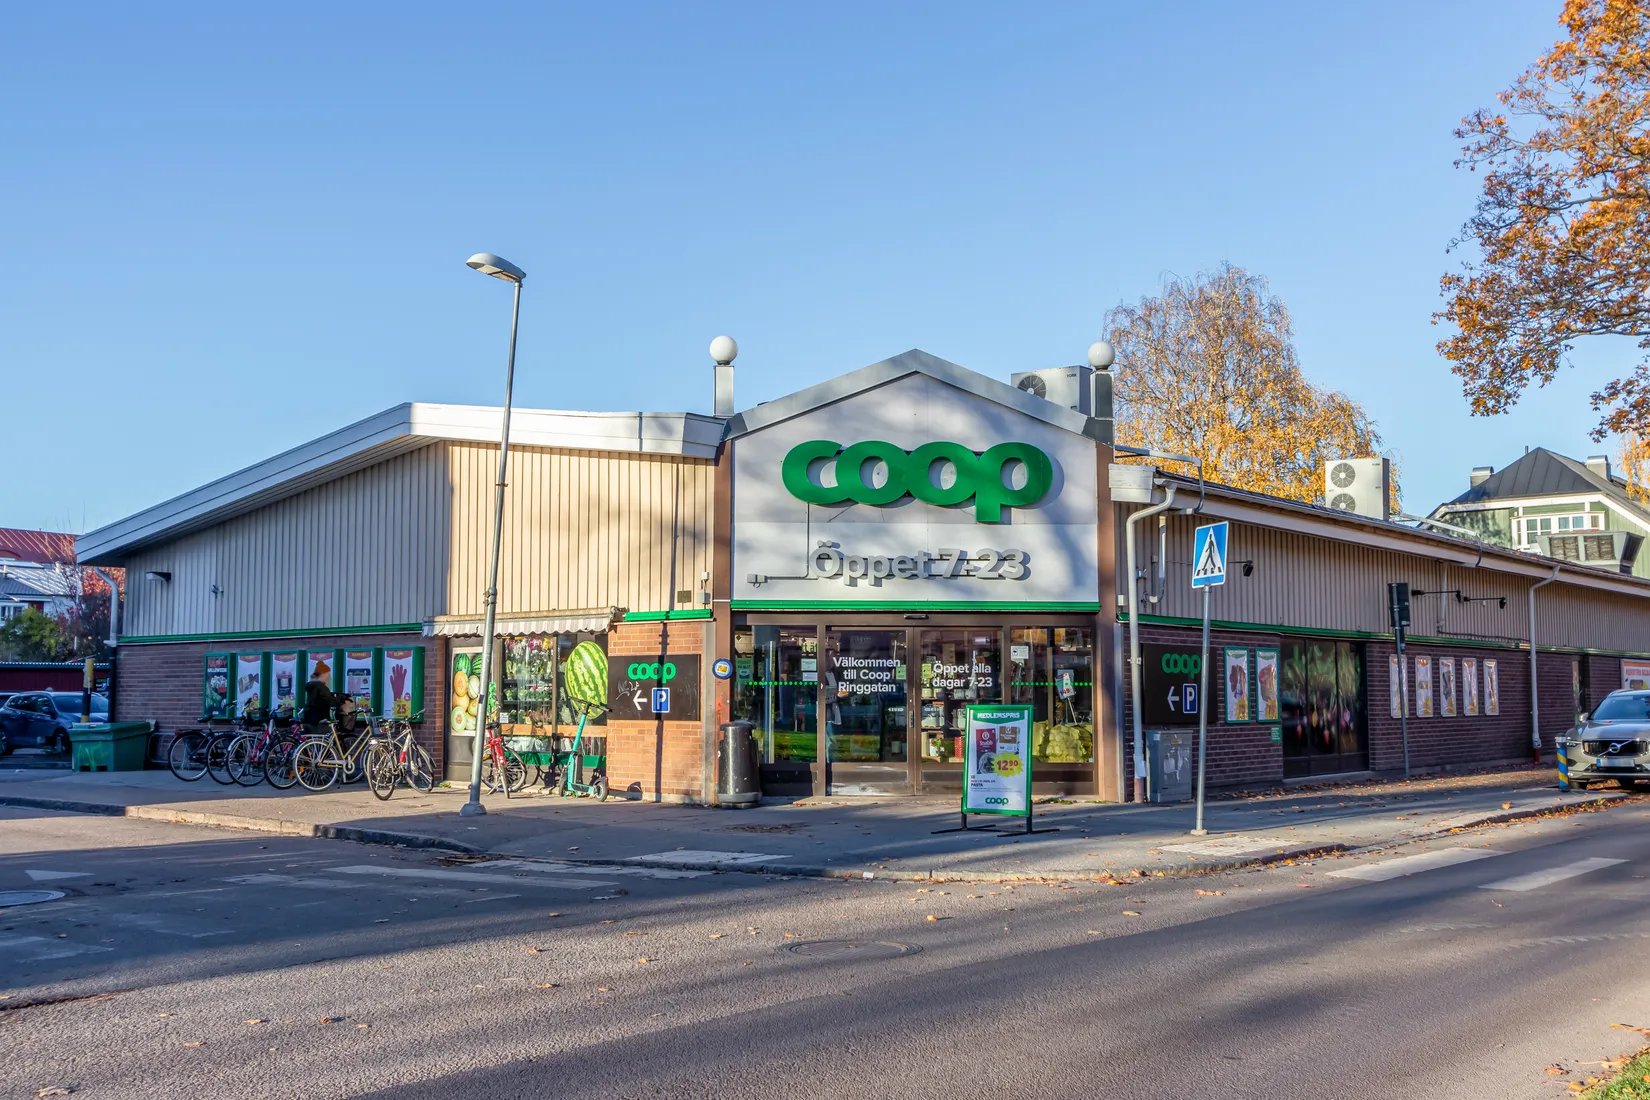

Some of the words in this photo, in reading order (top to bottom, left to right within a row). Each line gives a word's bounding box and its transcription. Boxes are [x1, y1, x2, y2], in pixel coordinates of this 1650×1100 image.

[782, 440, 1053, 522] coop
[809, 540, 928, 586] Öppet
[938, 548, 1025, 579] 7-23
[833, 656, 900, 667] Välkommen
[933, 661, 969, 677] Öppet
[972, 664, 991, 673] alla
[1161, 653, 1202, 679] coop
[627, 662, 676, 684] coop
[843, 669, 857, 680] till
[860, 669, 890, 682] Coop
[838, 682, 896, 694] Ringgatan
[932, 677, 965, 689] dagar
[967, 677, 993, 687] 7-23
[656, 690, 667, 710] P
[1186, 688, 1195, 710] P
[396, 703, 407, 714] 25
[985, 797, 1009, 806] coop
